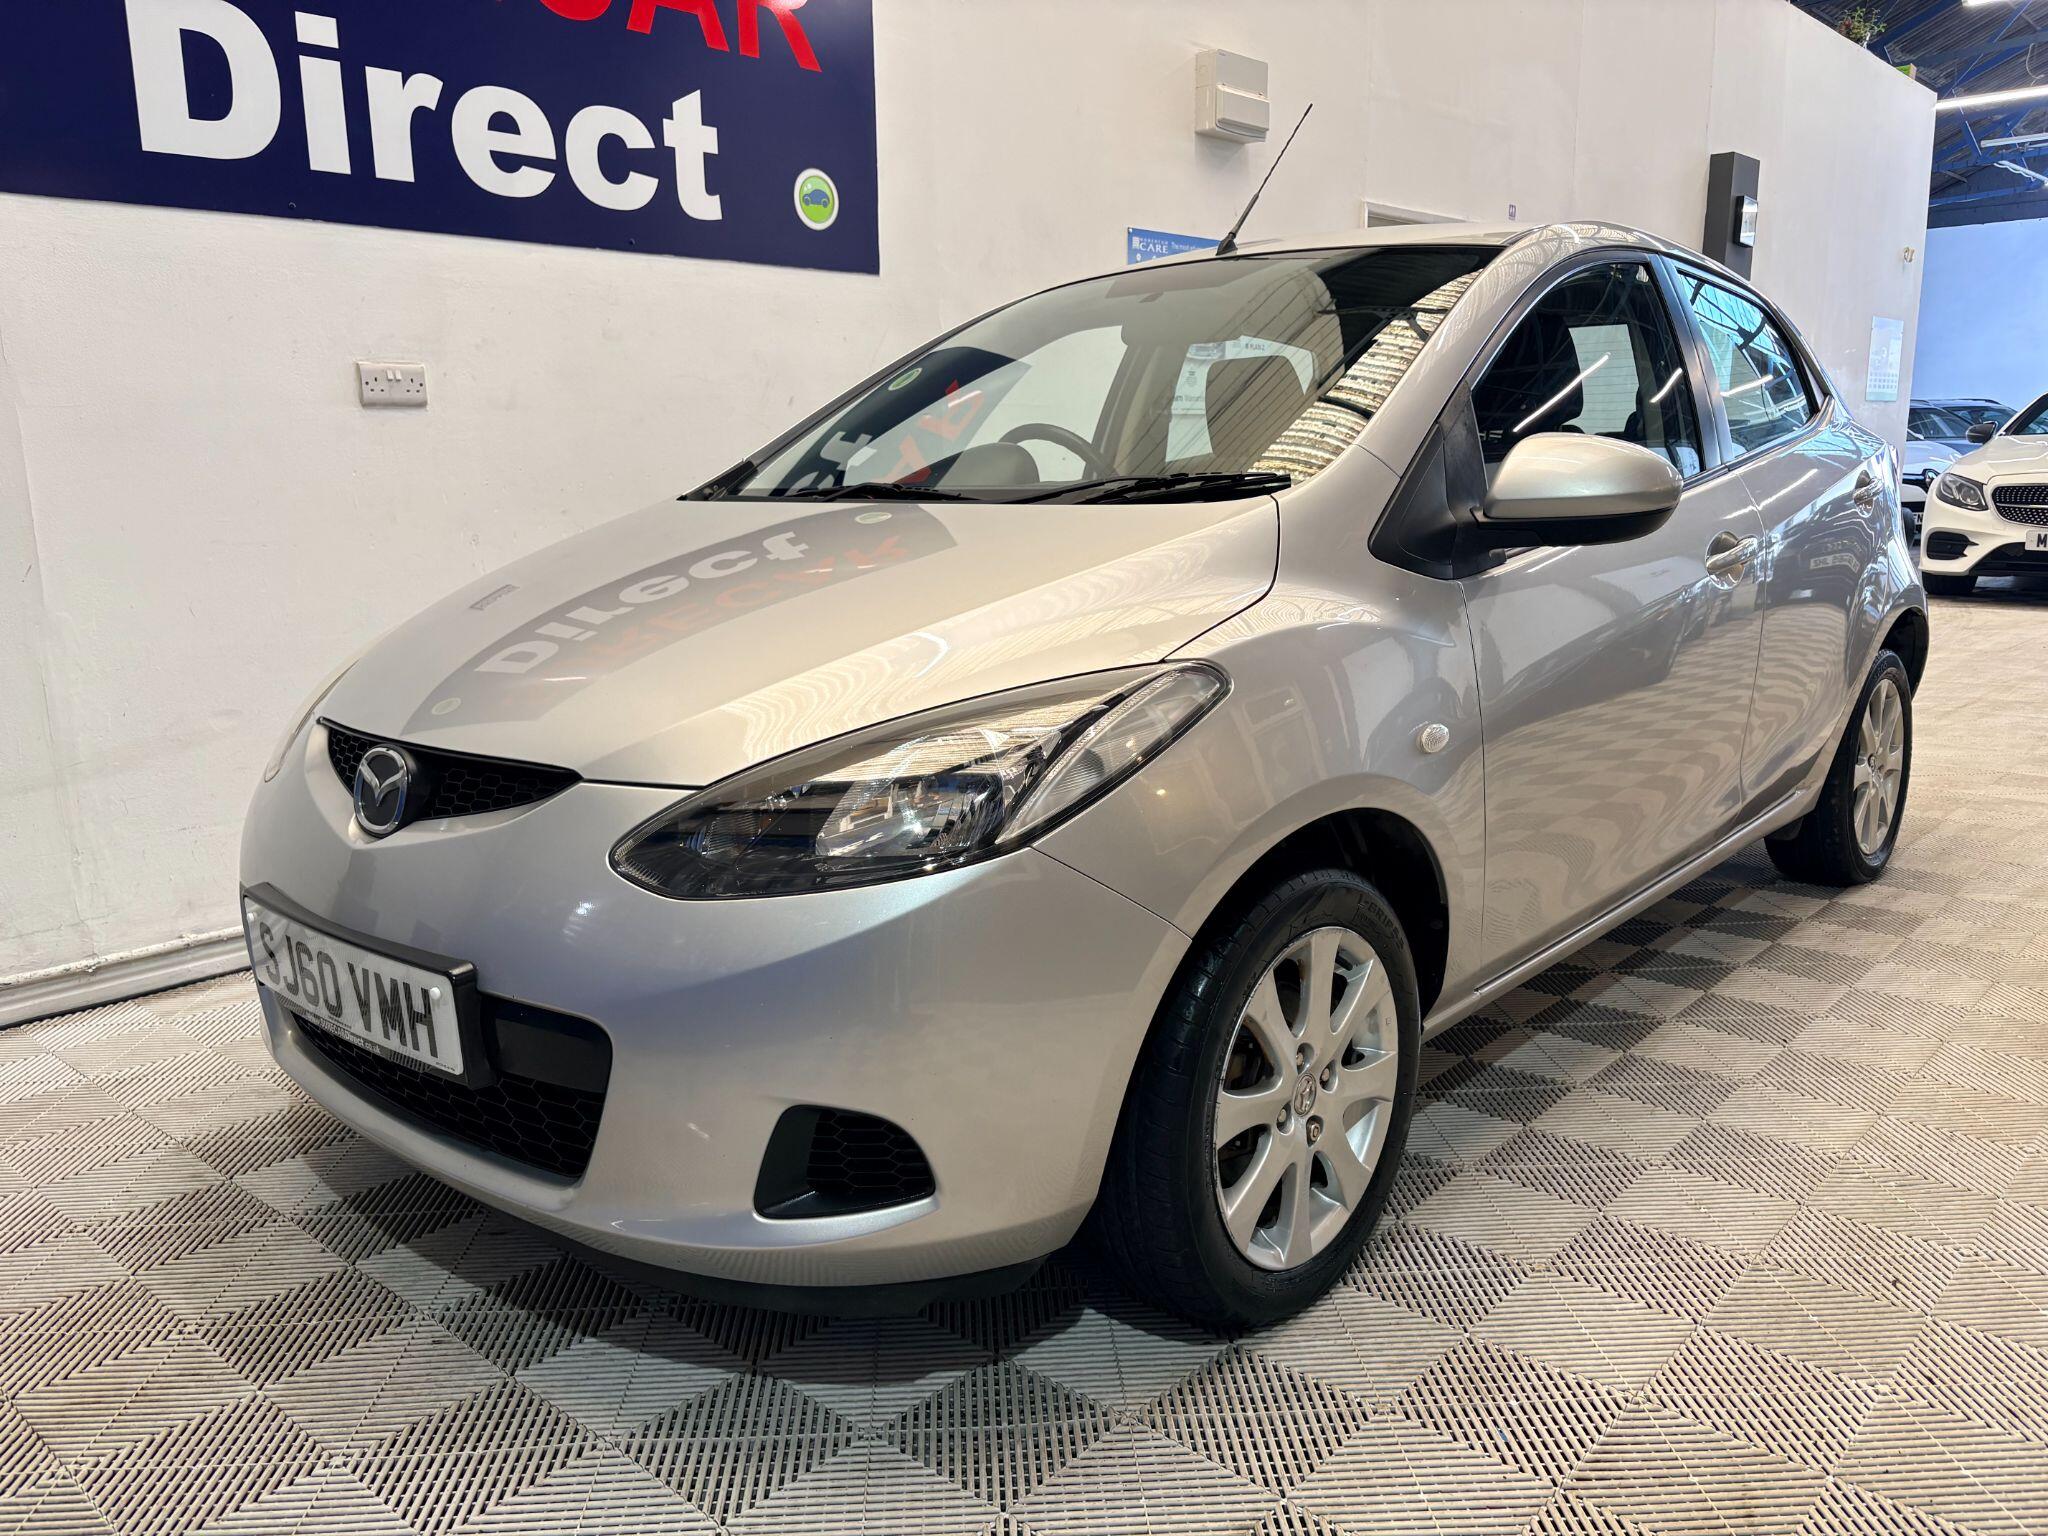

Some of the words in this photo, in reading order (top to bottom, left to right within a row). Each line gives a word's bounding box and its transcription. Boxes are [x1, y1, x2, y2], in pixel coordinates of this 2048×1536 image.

[125, 0, 723, 221] Direct
[1139, 243, 1169, 253] CARE
[258, 921, 343, 1019] SJ60
[346, 961, 439, 1059] VMH
